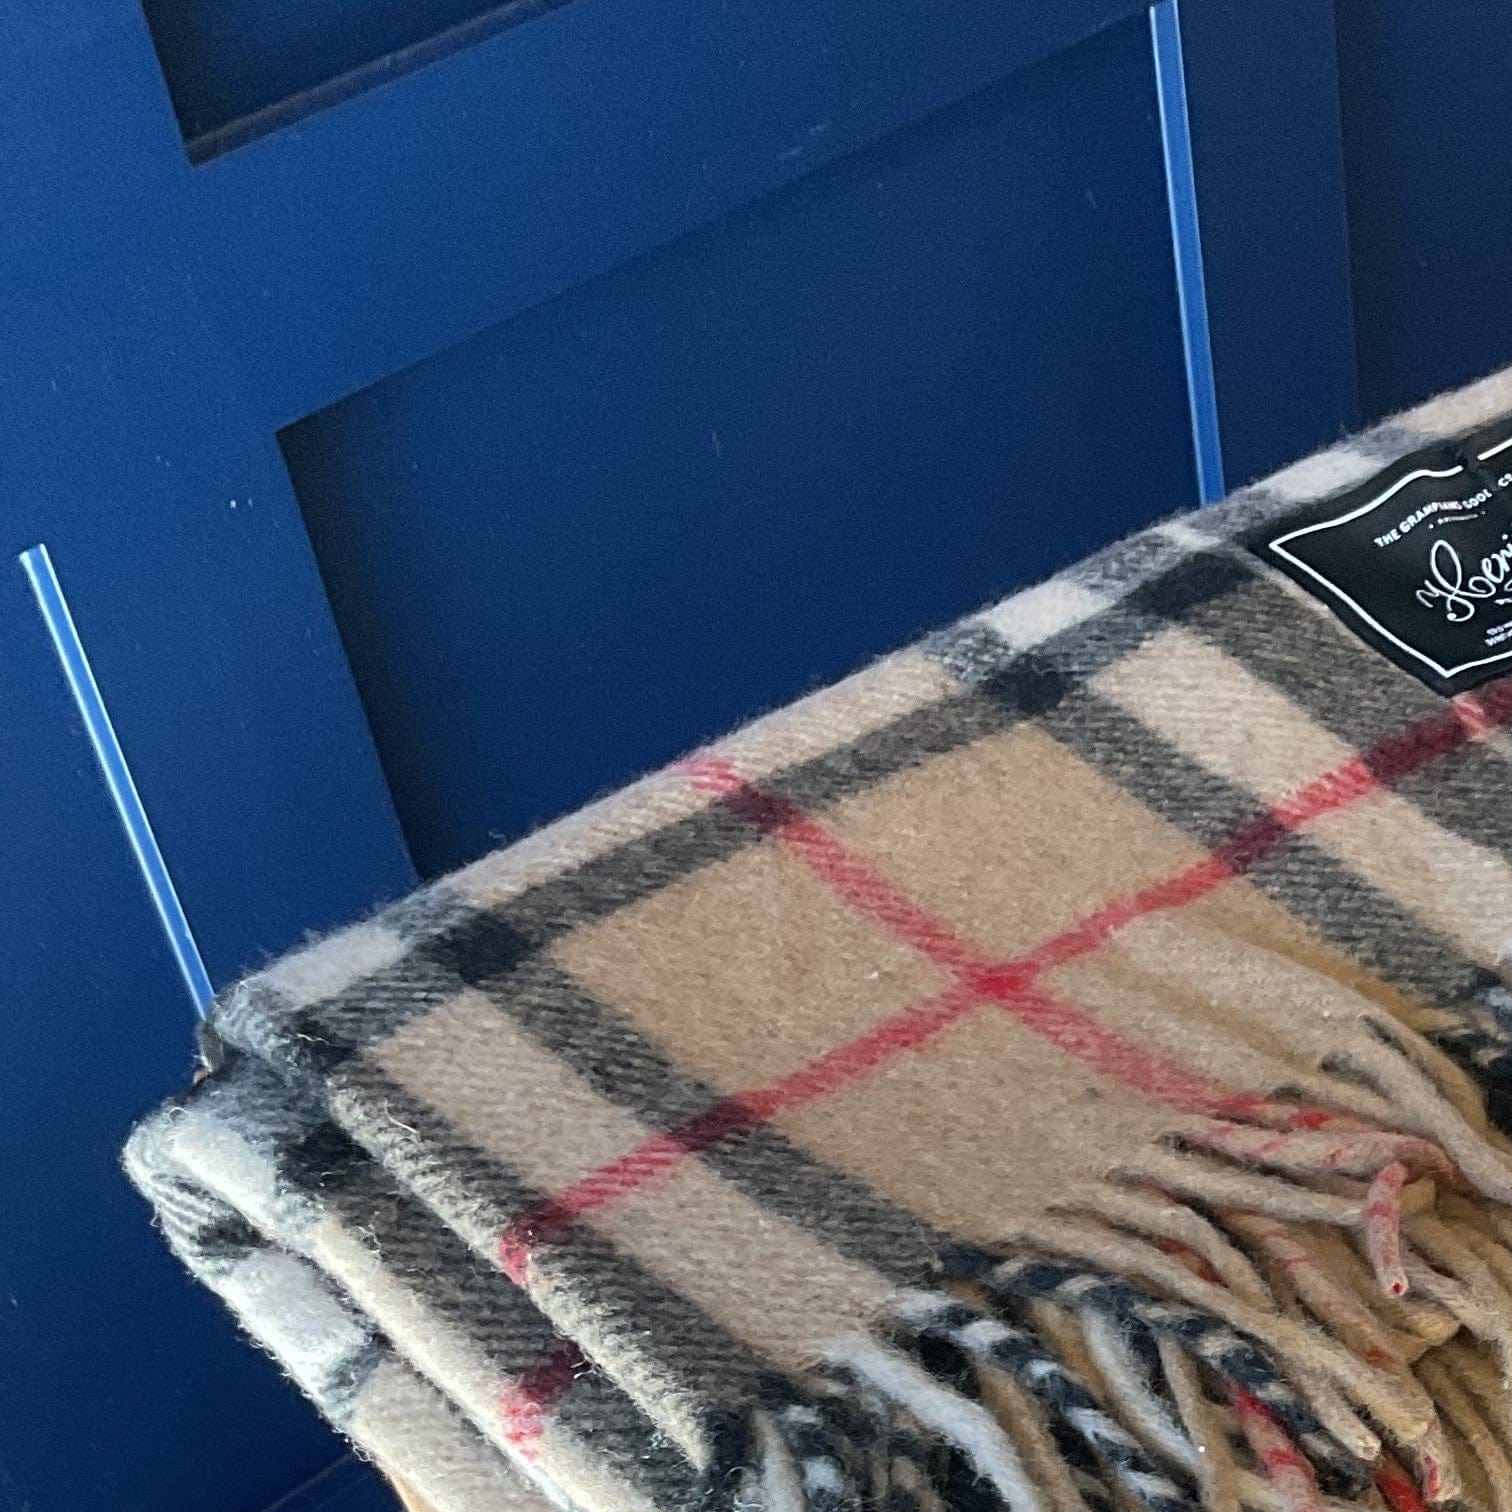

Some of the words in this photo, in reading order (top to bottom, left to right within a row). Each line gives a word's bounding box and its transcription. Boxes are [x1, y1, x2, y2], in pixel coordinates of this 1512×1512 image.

[1374, 528, 1401, 547] THE
[1399, 500, 1463, 533] GRAMPIANS
[1462, 488, 1493, 509] GOO
